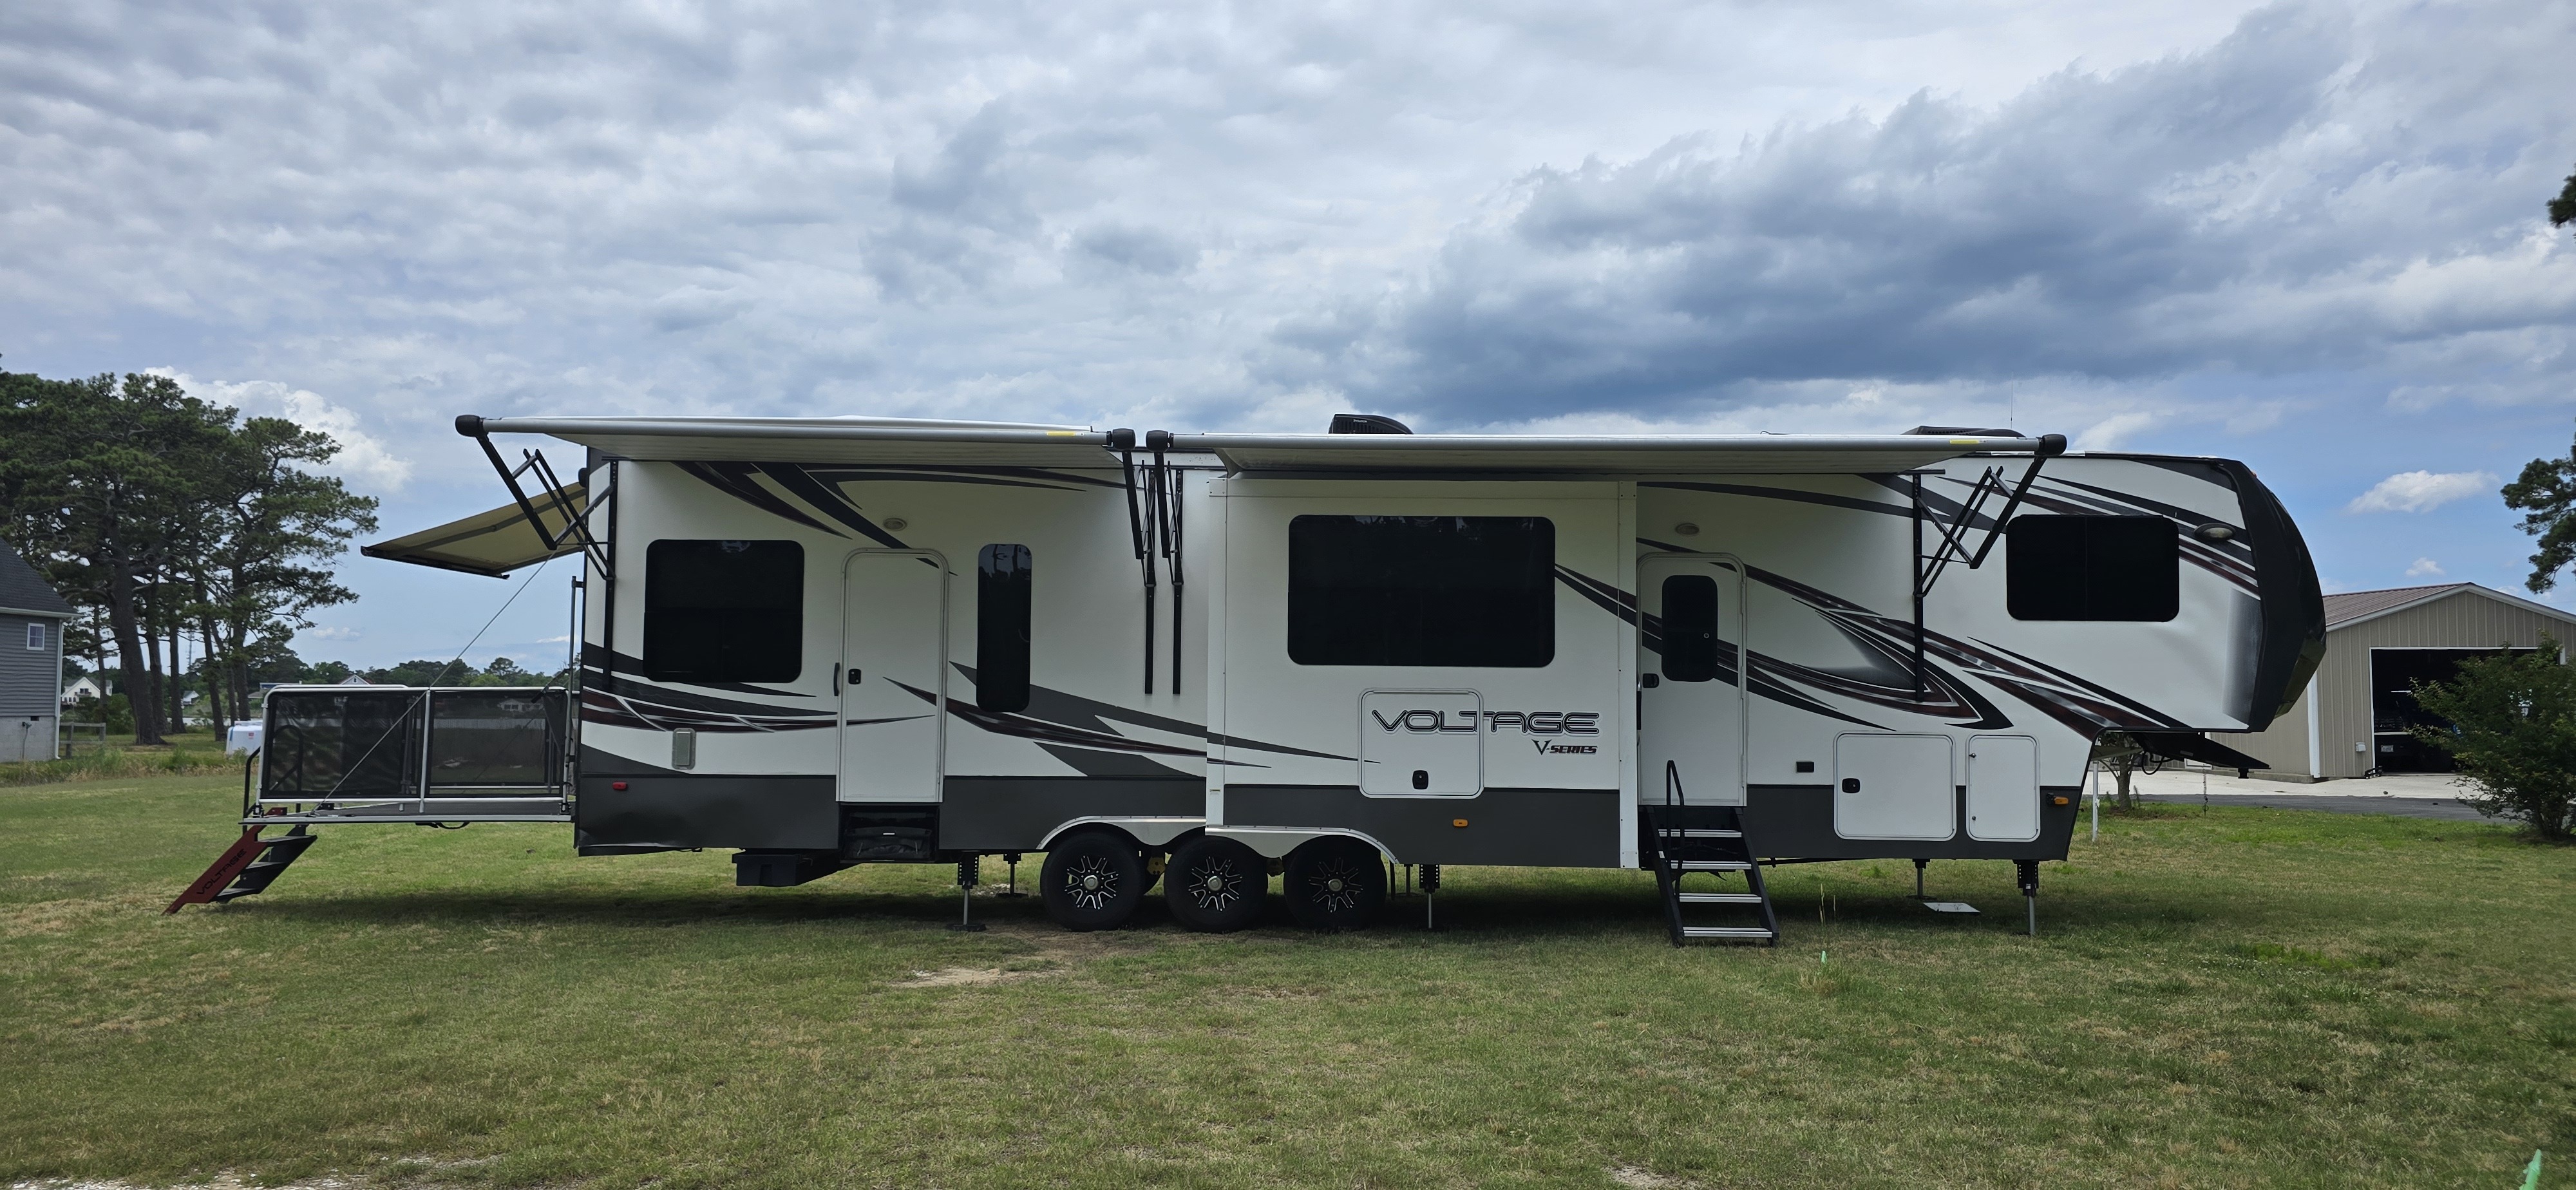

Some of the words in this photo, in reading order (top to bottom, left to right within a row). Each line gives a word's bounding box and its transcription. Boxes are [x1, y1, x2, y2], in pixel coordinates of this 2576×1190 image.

[1372, 710, 1600, 734] VOLTAGE
[1531, 739, 1598, 755] V-SERIES
[196, 848, 247, 895] VOLTAGE
